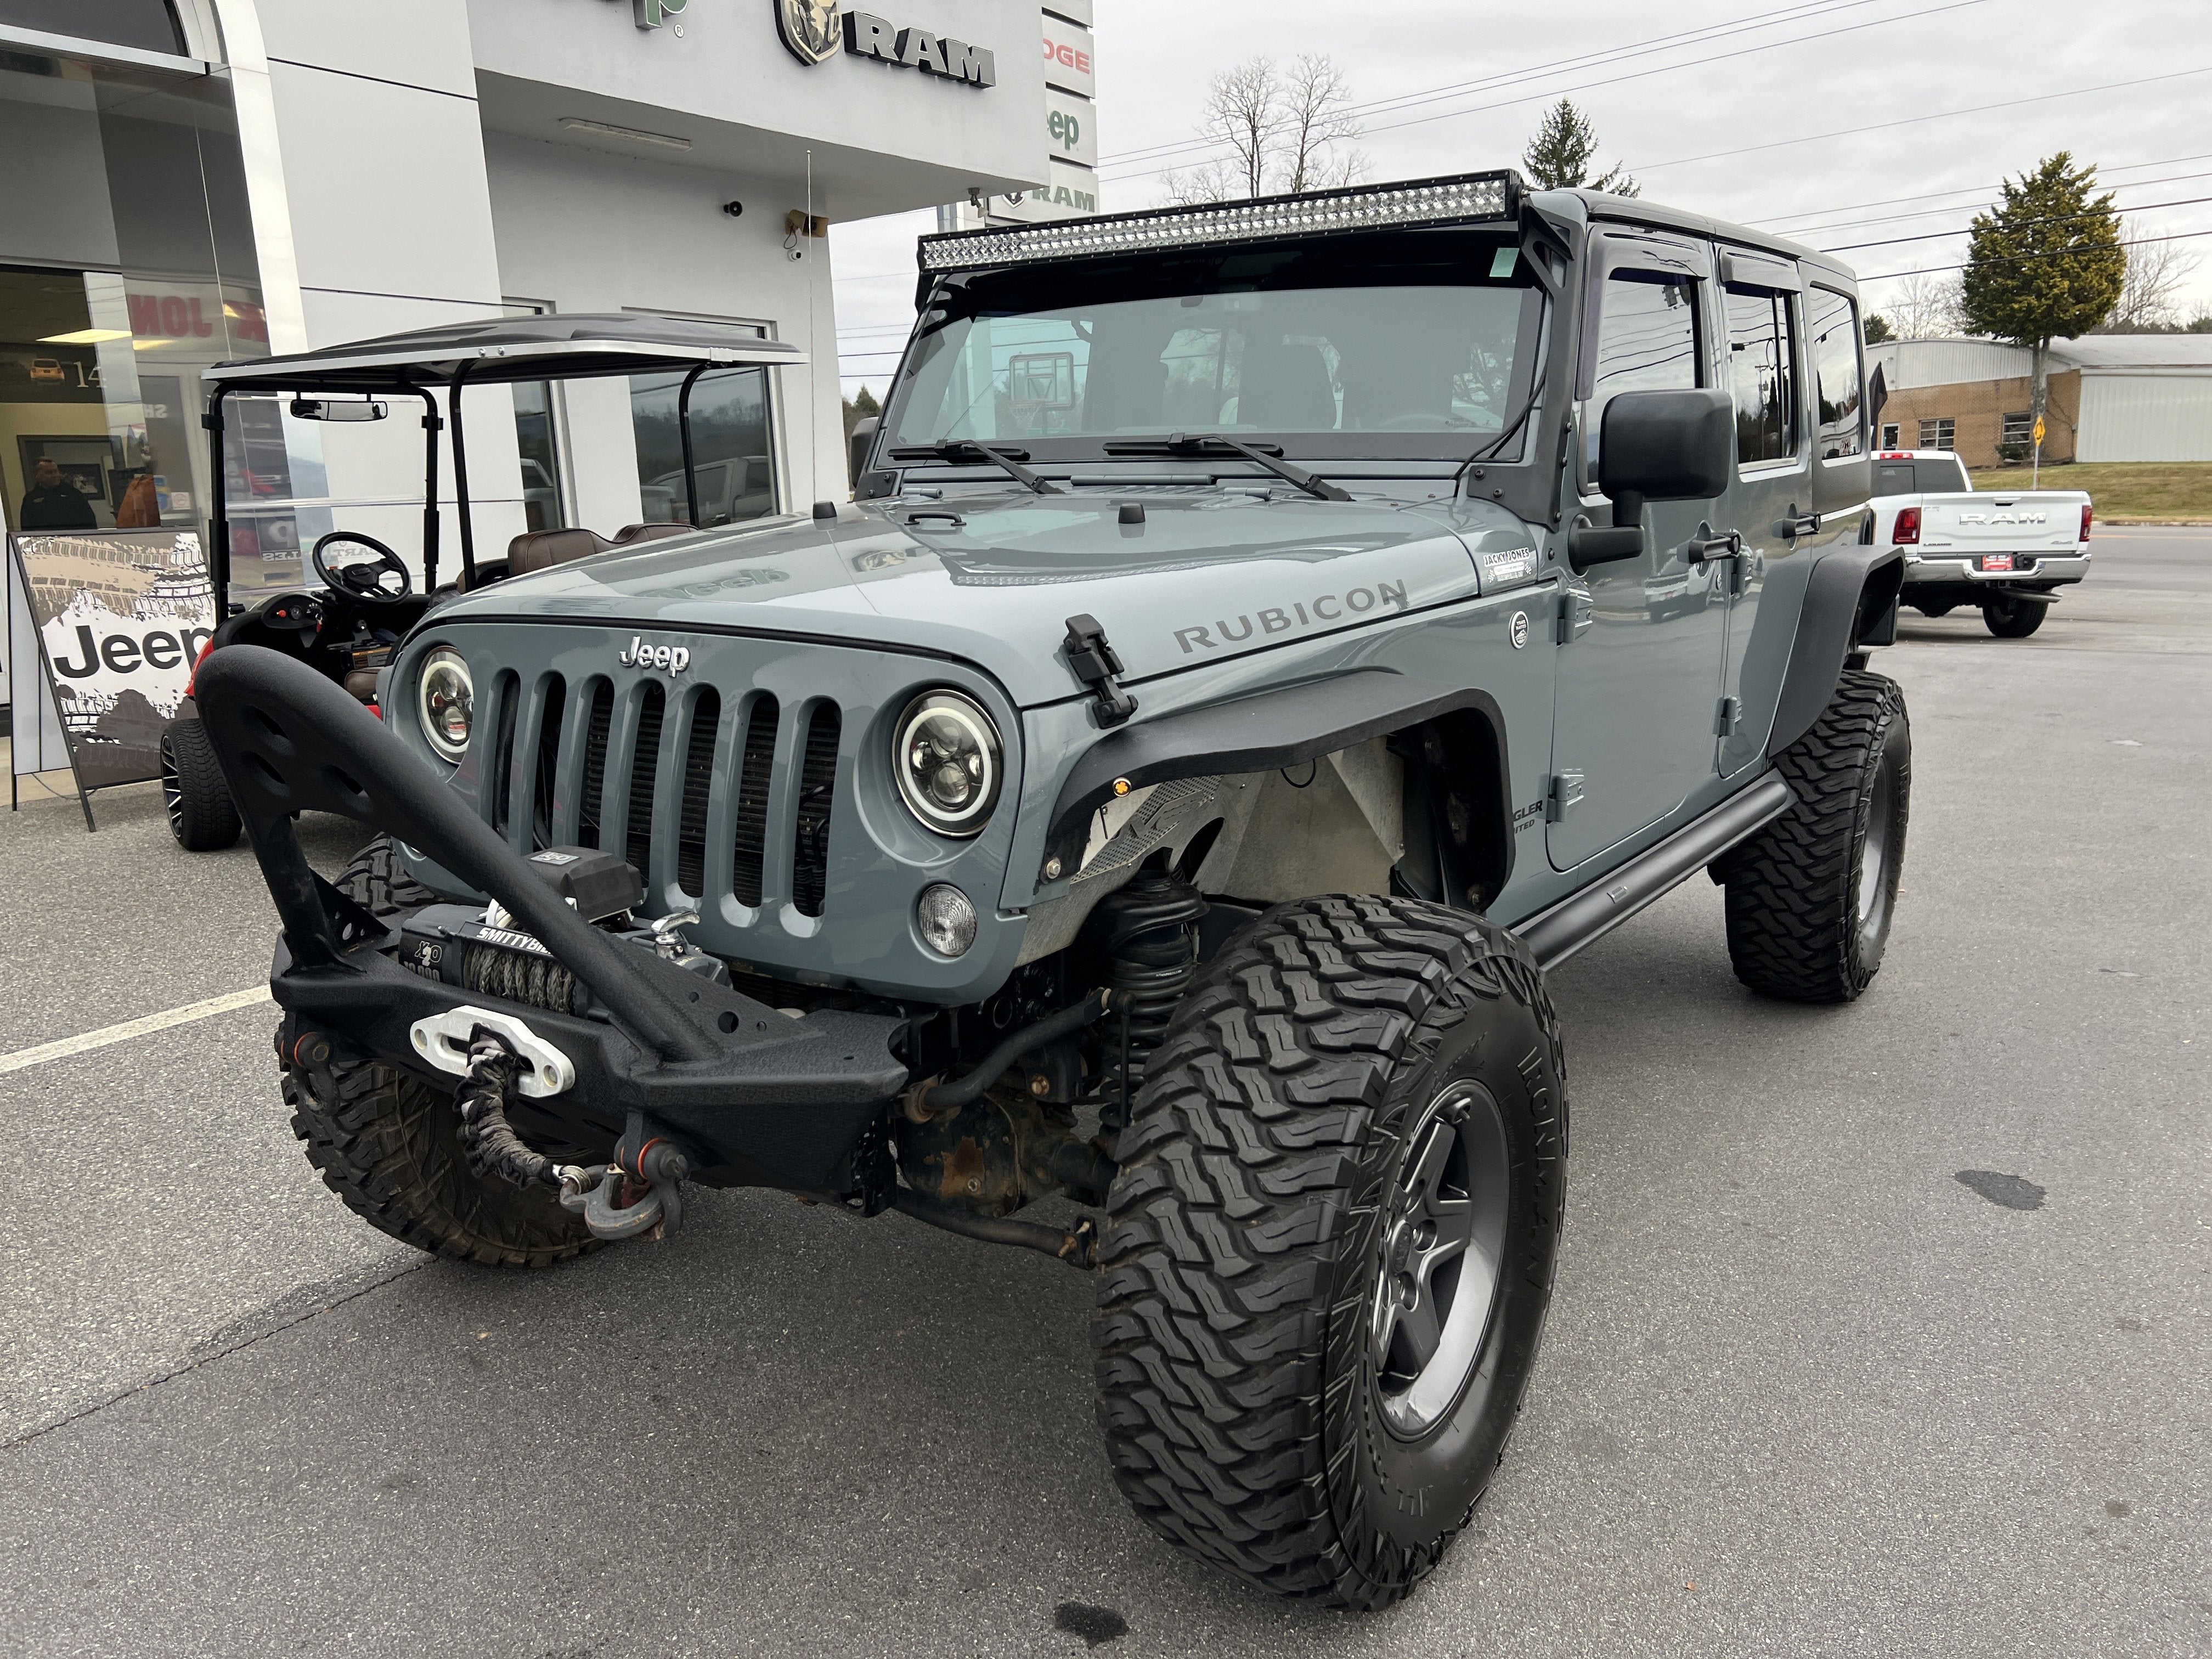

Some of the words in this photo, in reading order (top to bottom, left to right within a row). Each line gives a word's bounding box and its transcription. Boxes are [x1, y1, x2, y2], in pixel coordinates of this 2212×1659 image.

[842, 10, 996, 88] RAM
[1043, 38, 1091, 74] DGE
[1959, 512, 2047, 525] RAM
[1483, 552, 1506, 567] JACKY
[1506, 548, 1530, 562] JONES
[1173, 579, 1409, 654] RUBICON
[619, 636, 691, 678] Jeep
[1514, 800, 1543, 822] GLER
